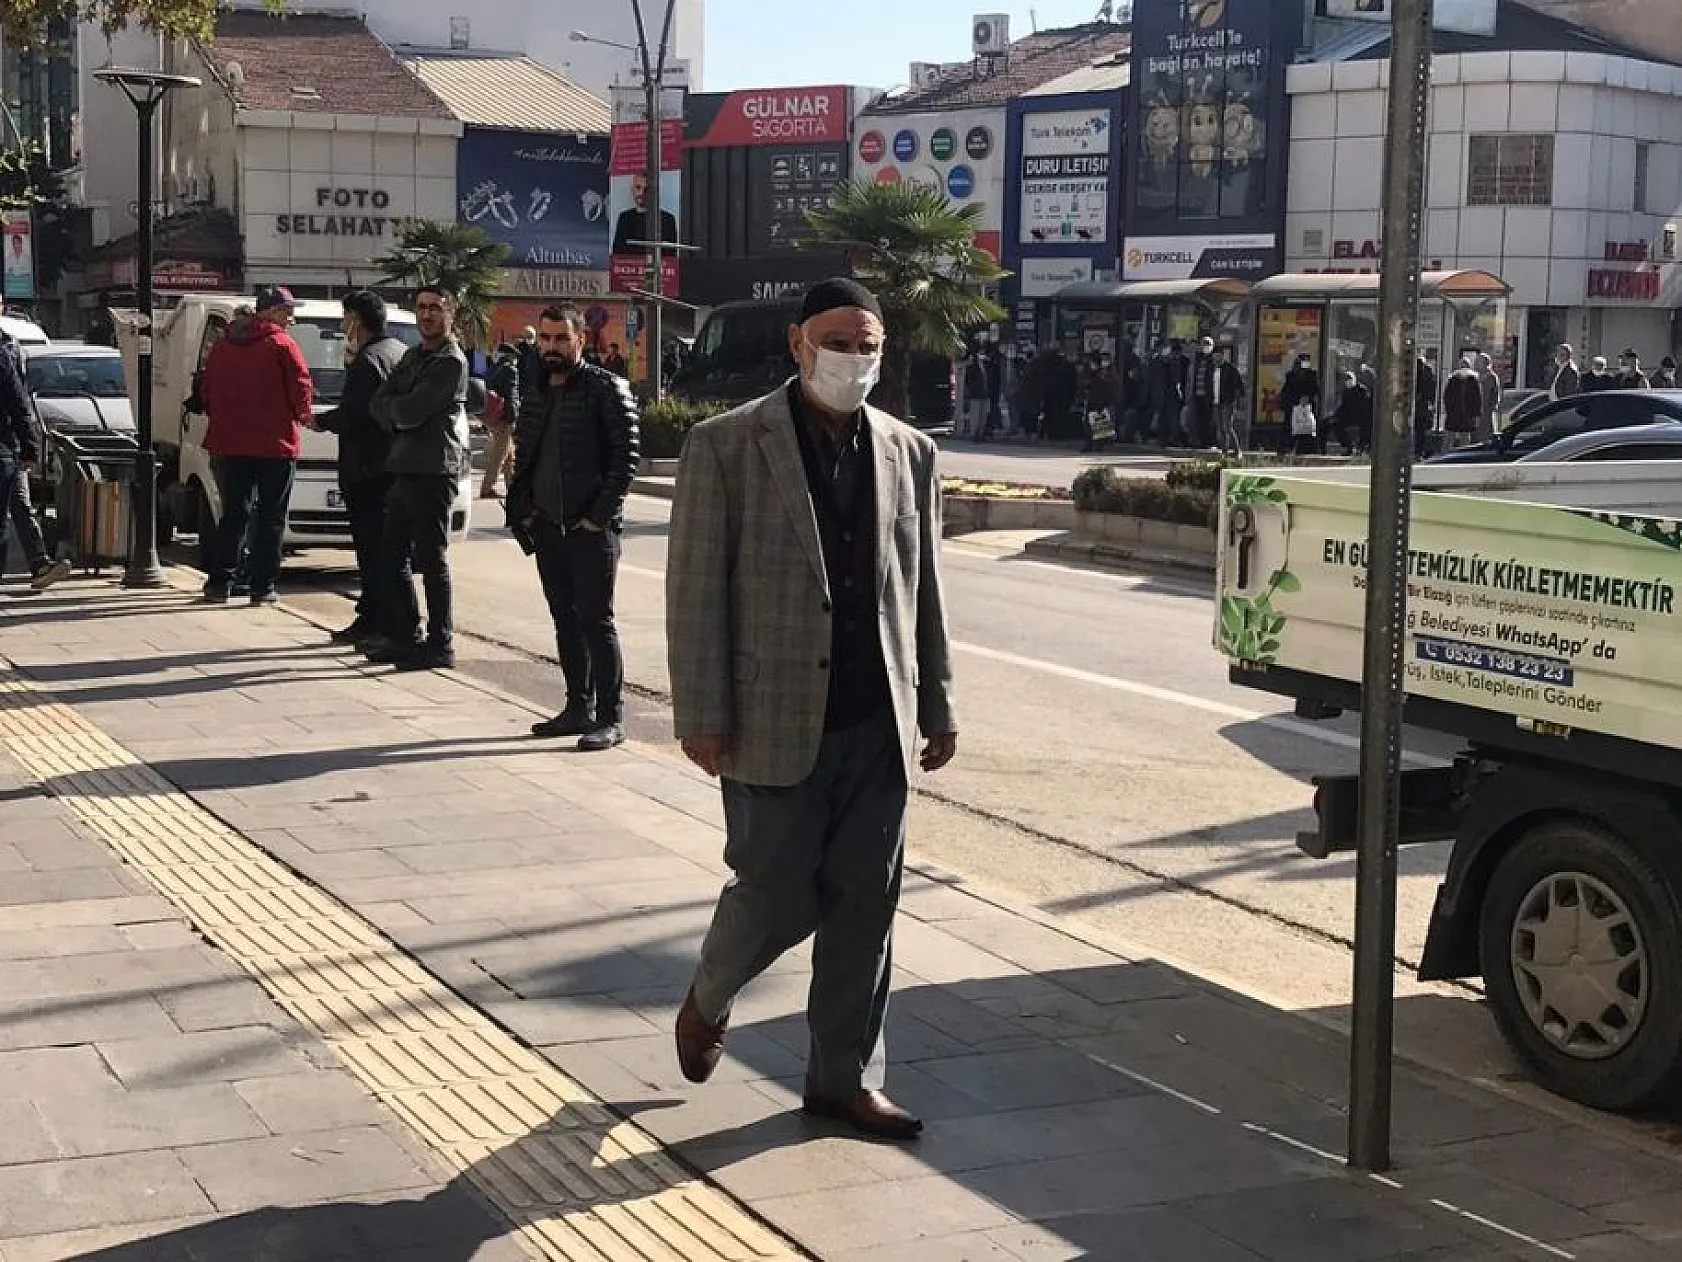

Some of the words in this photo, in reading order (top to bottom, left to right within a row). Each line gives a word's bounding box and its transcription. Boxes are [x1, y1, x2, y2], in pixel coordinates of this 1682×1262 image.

[743, 95, 829, 118] GÜLNAR
[316, 187, 390, 209] FOTO
[1144, 251, 1194, 263] TURKCELL
[1333, 239, 1382, 260] ELA
[1324, 538, 1346, 565] EN
[1420, 610, 1492, 638] Belediyesi
[1593, 639, 1617, 660] da
[1543, 687, 1603, 713] Gönder
